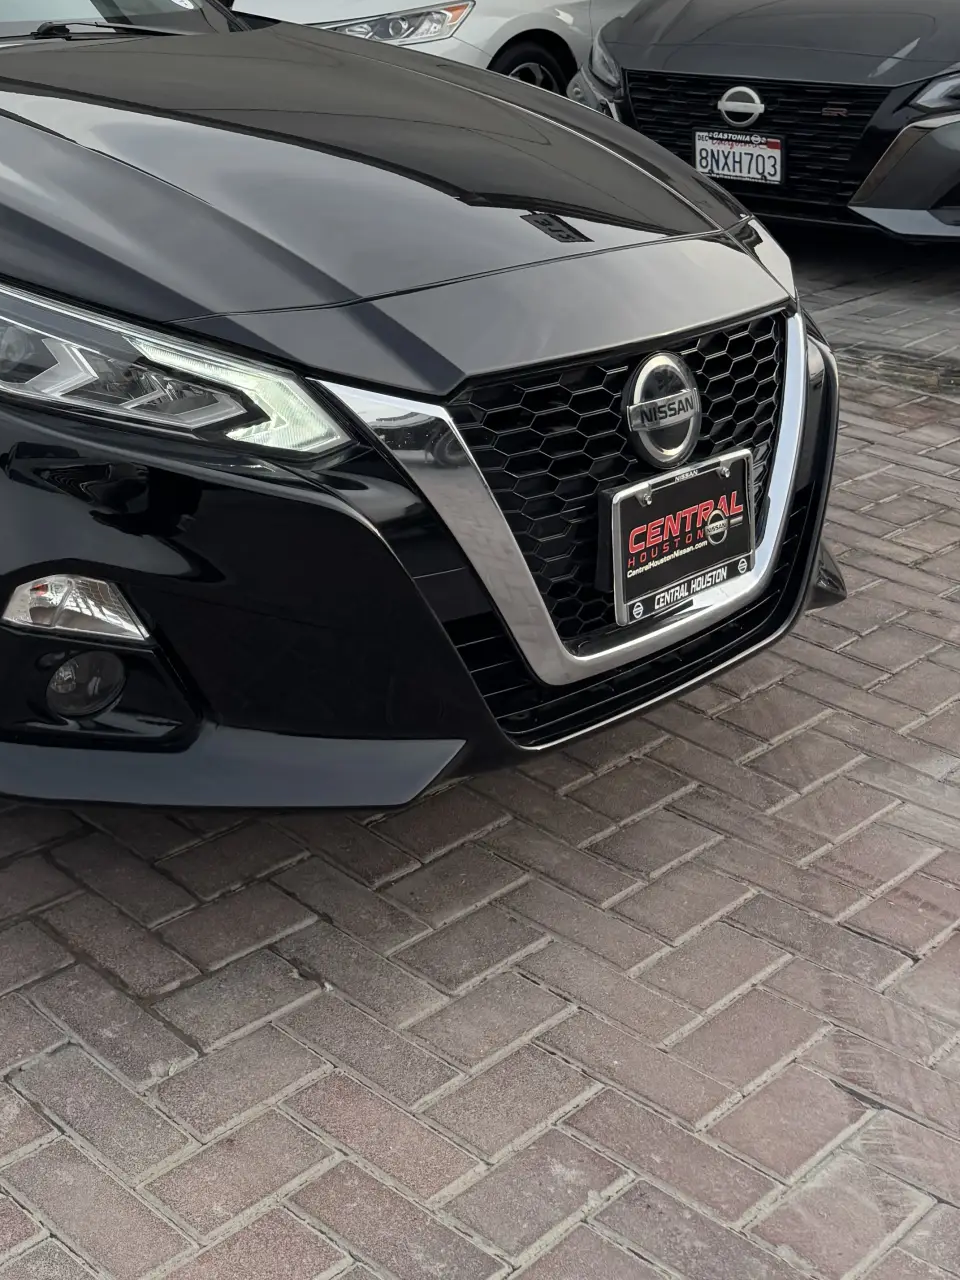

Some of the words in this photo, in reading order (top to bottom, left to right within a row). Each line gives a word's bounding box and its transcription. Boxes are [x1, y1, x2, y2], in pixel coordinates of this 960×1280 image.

[713, 132, 750, 142] GASTONIA
[699, 148, 778, 178] 8NXH703
[640, 396, 694, 424] NISSAN
[674, 469, 699, 482] NISSAN
[629, 490, 744, 554] CENTRAL
[706, 522, 727, 534] NISSAN
[627, 540, 708, 578] CentralHoustonNissan.com
[628, 528, 705, 568] HOUSTON
[654, 582, 689, 610] CENTRAL
[690, 566, 728, 594] HOUSTON
